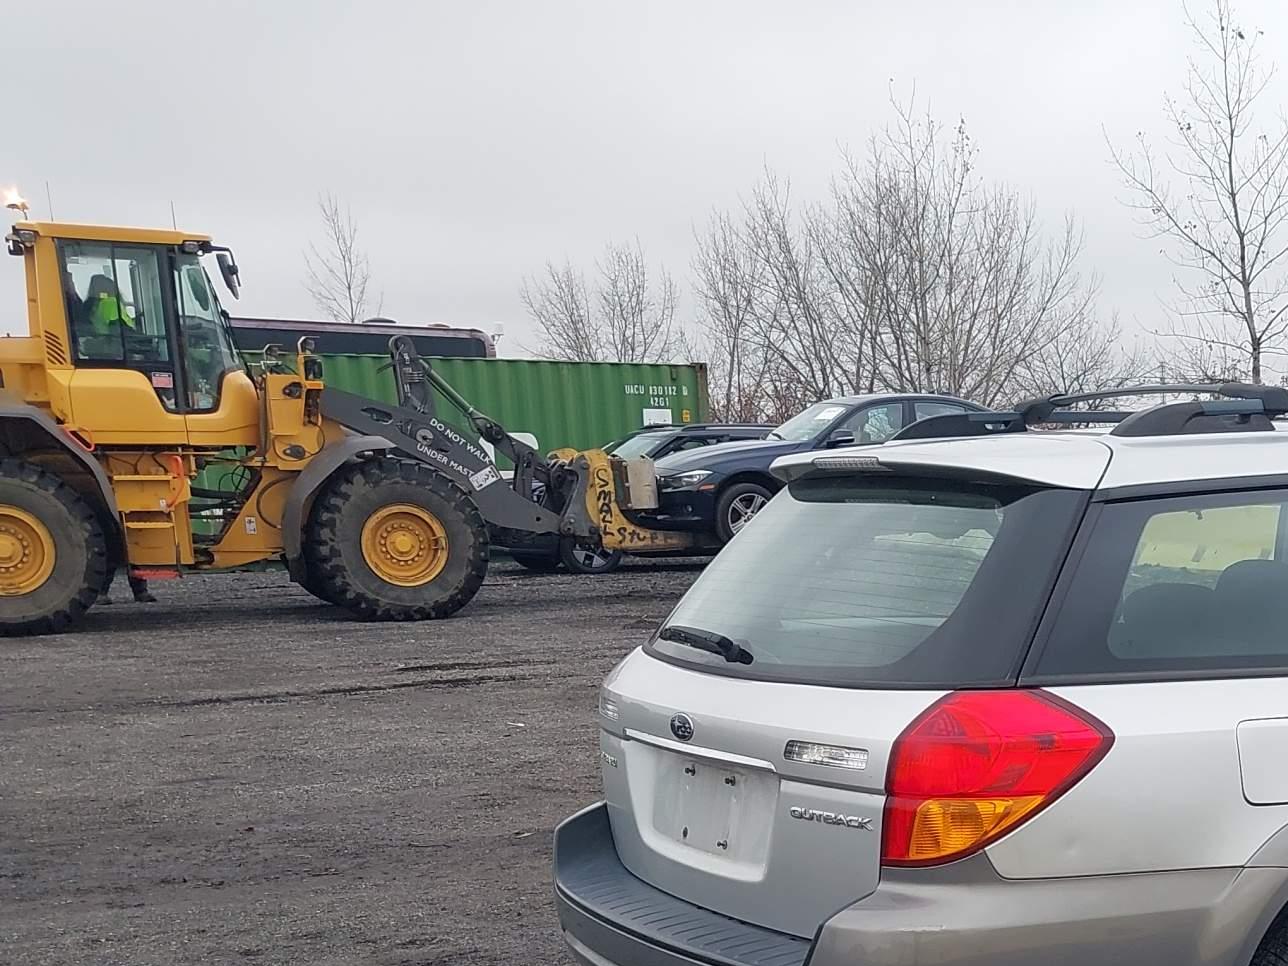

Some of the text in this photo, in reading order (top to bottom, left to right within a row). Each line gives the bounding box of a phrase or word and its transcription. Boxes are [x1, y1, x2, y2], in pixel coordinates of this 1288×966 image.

[429, 418, 491, 465] DO NOT WALK
[416, 443, 475, 477] UNDER MAST
[790, 806, 873, 832] OUTBACK
